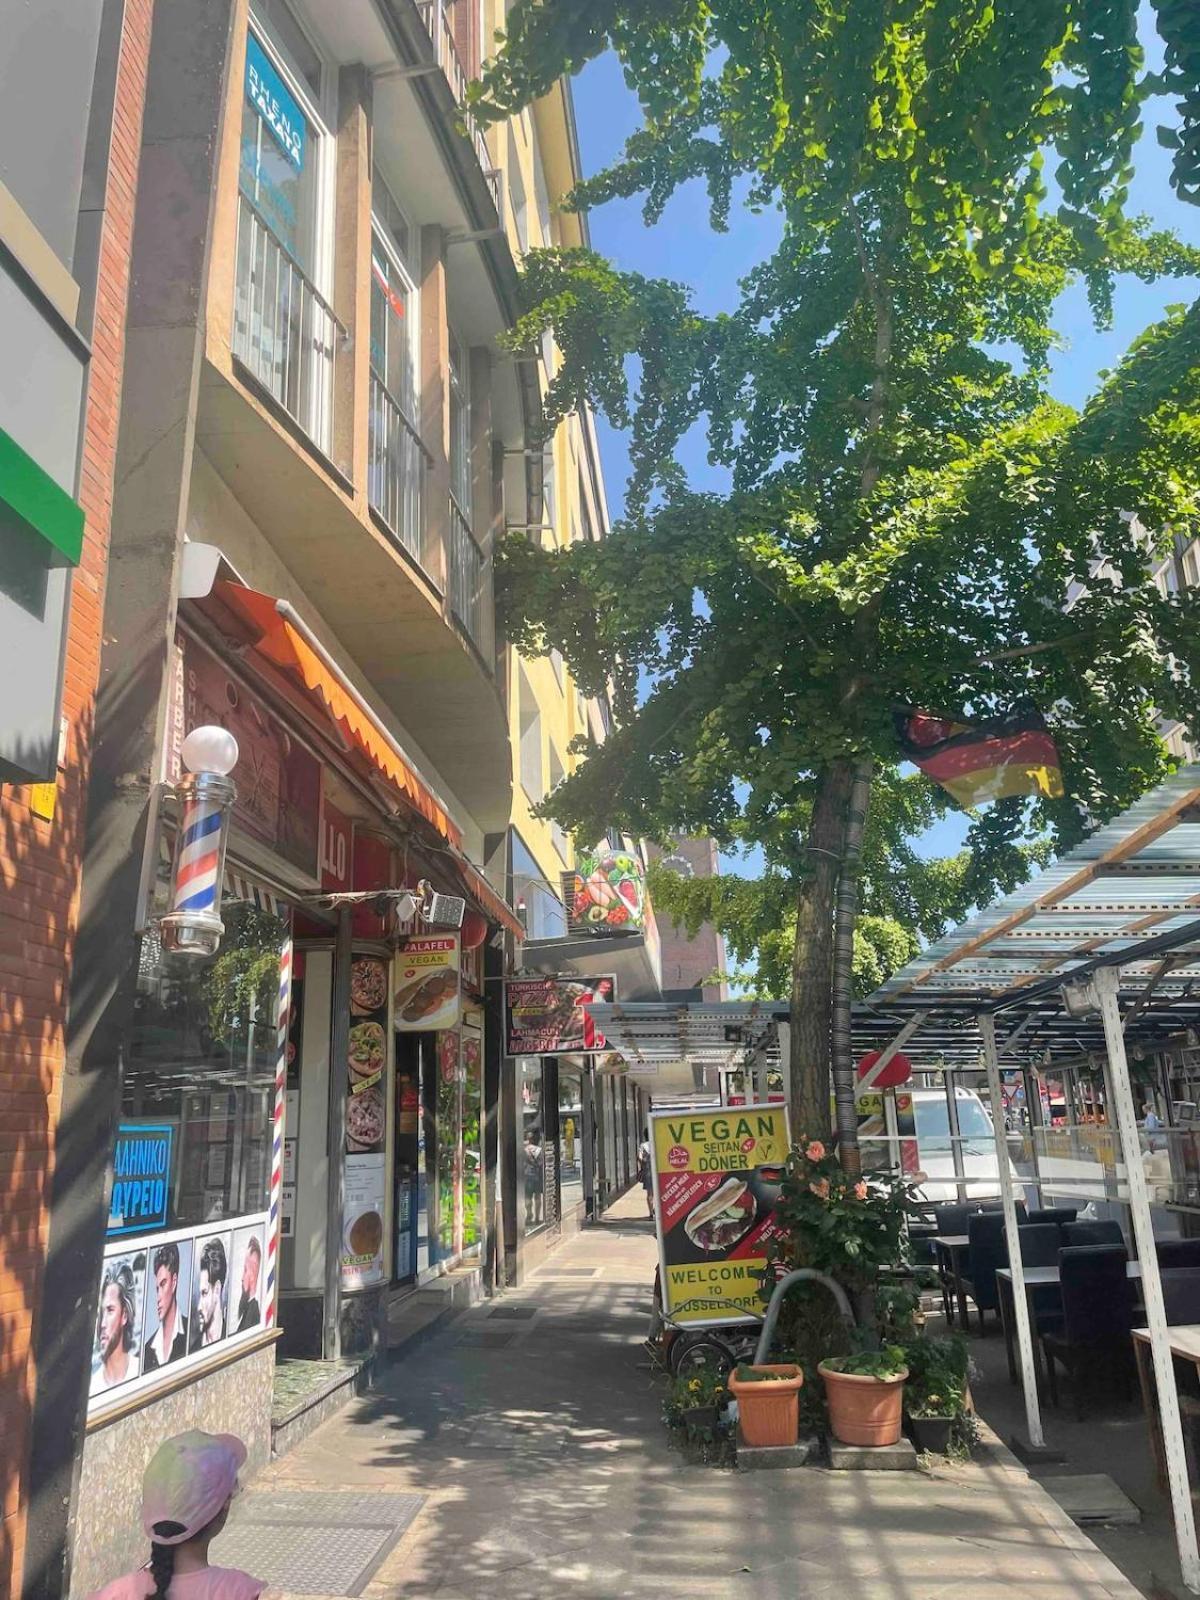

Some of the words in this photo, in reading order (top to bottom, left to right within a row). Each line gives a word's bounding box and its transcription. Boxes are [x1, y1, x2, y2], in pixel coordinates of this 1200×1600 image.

[249, 64, 301, 150] RHENO
[249, 78, 301, 166] TAXATA
[173, 632, 185, 778] BARBER
[404, 941, 450, 951] FALAFEL
[409, 954, 444, 964] VEGAN
[507, 990, 559, 1008] PIZZA
[667, 1115, 775, 1143] VEGAN
[703, 1141, 741, 1154] SEITAN
[698, 1153, 750, 1171] DÖNER
[671, 1265, 756, 1284] WELCOME
[708, 1286, 722, 1295] TO
